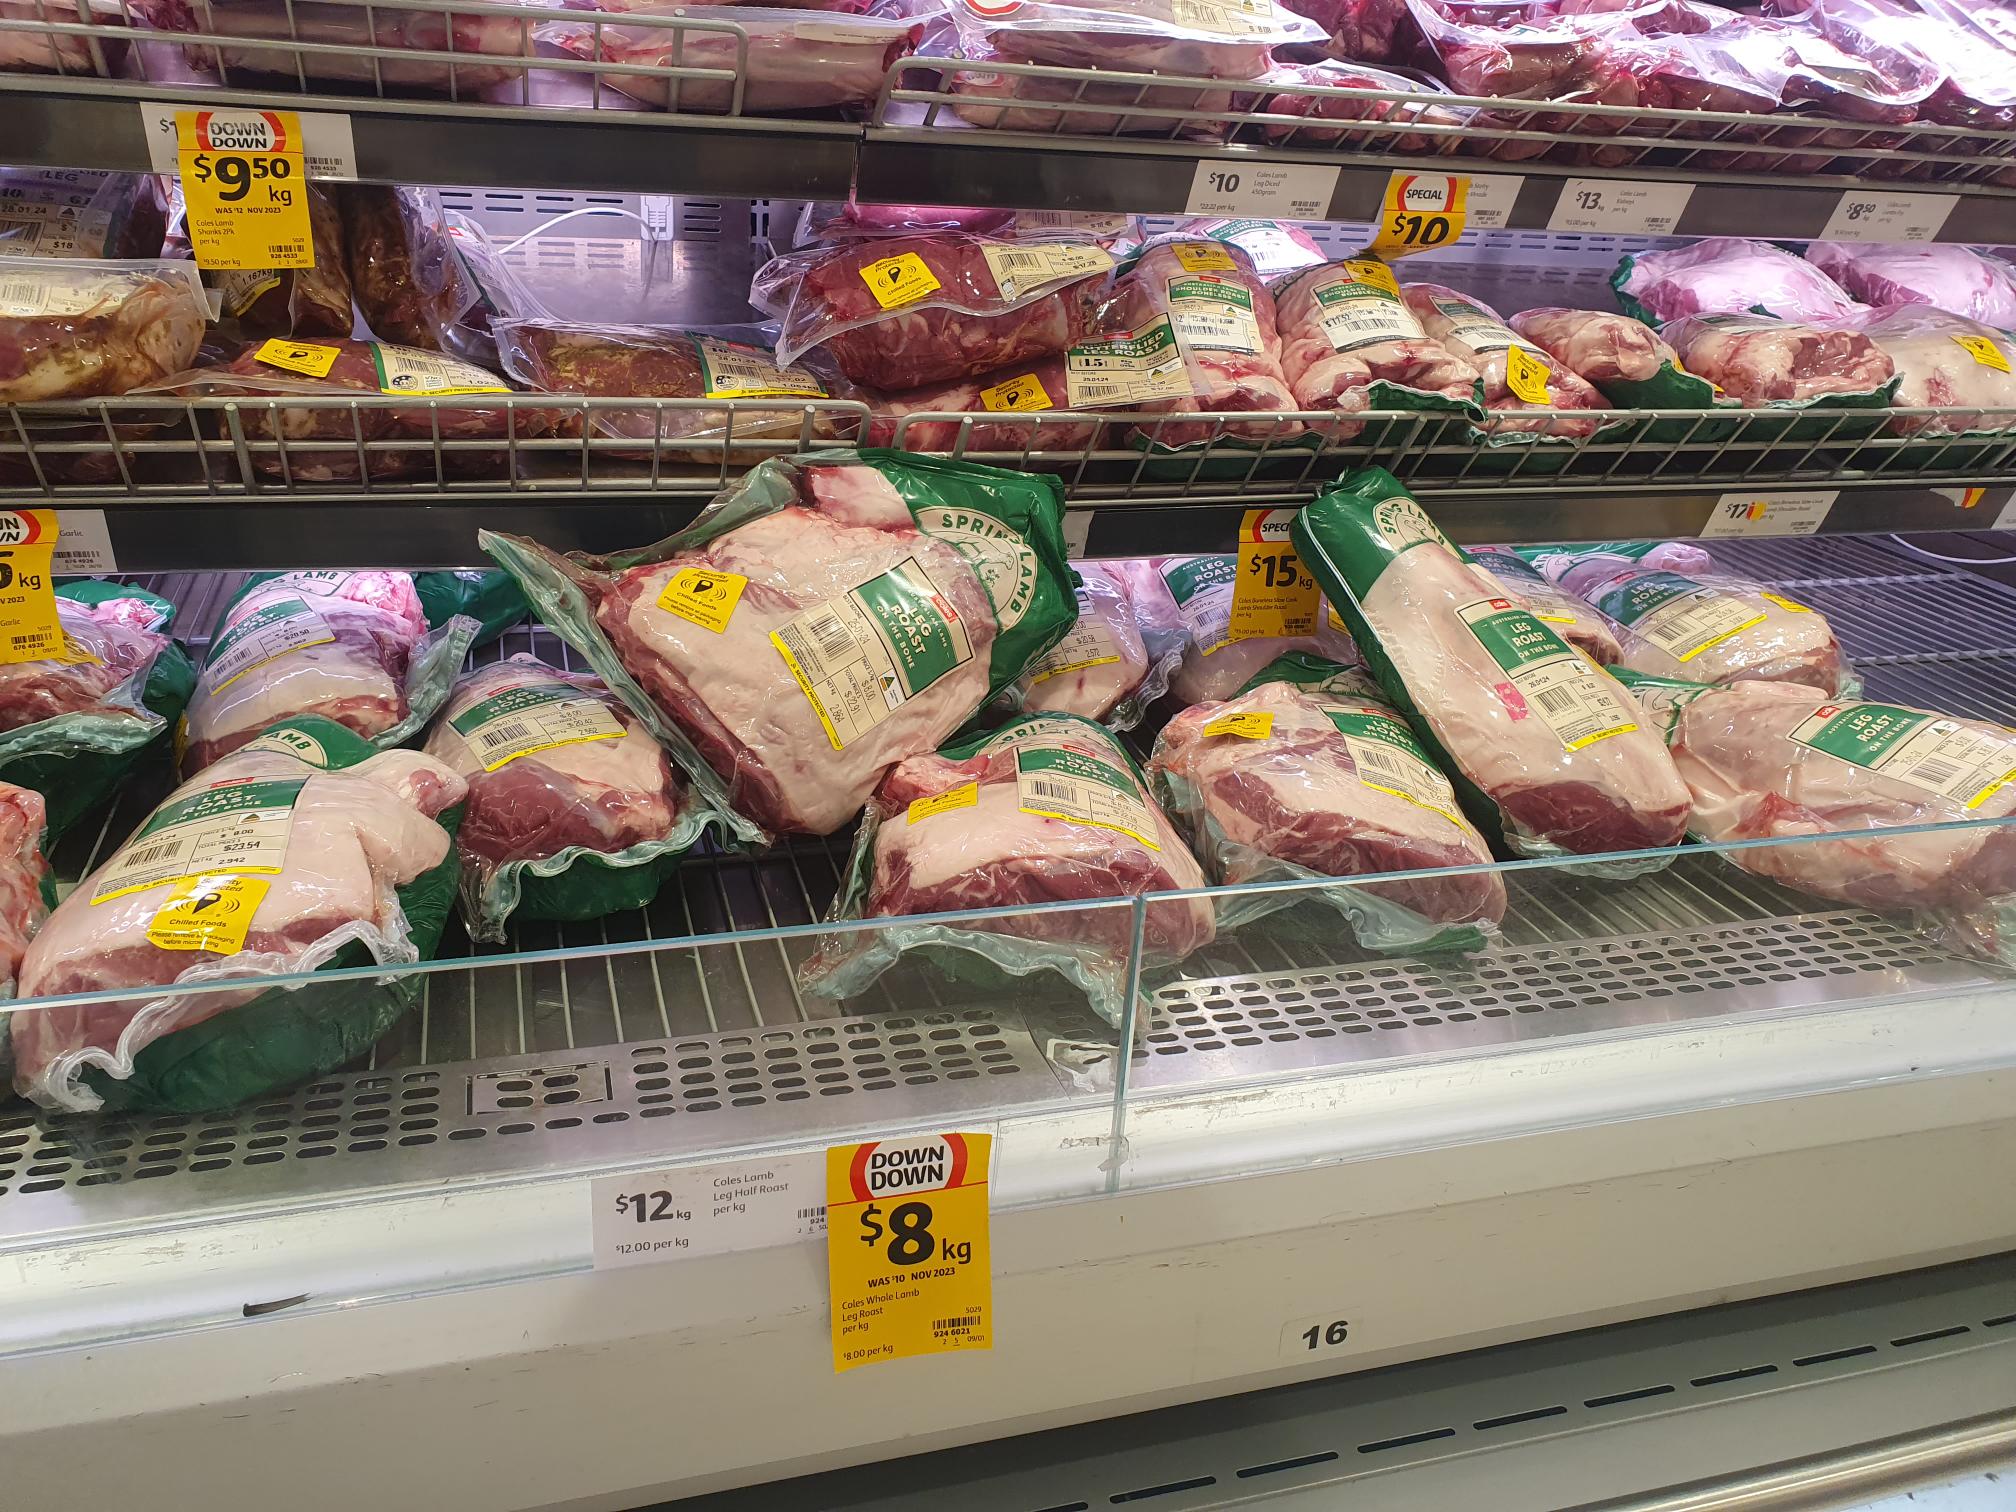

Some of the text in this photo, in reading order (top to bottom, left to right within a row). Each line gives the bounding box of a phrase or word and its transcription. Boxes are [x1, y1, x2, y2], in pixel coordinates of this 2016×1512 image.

[211, 122, 265, 136] DOWN
[213, 137, 267, 149] DOWN
[45, 170, 78, 181] LEG
[1209, 172, 1240, 193] $10
[269, 185, 292, 206] kg
[1406, 189, 1443, 200] SPECIAL
[1575, 190, 1602, 210] $13
[1227, 204, 1235, 212] kg
[196, 219, 234, 227] Coles Lamb
[1391, 212, 1450, 246] $10
[198, 228, 222, 236] Shanks
[200, 237, 220, 246] per kg
[220, 259, 231, 267] per
[232, 258, 241, 267] kg
[1176, 285, 1220, 295] SHOULDER
[1191, 290, 1232, 300] BONELESS
[1077, 332, 1165, 350] BUTTERFLIED
[1114, 343, 1160, 357] ROAST
[1725, 503, 1748, 519] $17
[1194, 564, 1236, 582] ROAST
[1200, 560, 1225, 572] LEG
[1250, 553, 1313, 590] $15 kg
[19, 572, 41, 590] kg
[293, 572, 339, 581] LAMB
[1010, 551, 1033, 613] LAMB
[1631, 582, 1654, 595] LEG
[1632, 583, 1670, 604] ROAST
[7, 596, 25, 604] 2023
[891, 604, 927, 654] ROAST
[909, 607, 932, 637] LEG
[1510, 622, 1532, 634] LEG
[876, 605, 915, 669] ON THE BONE
[938, 628, 947, 648] LAMB
[1512, 632, 1546, 648] ROAST
[1519, 647, 1543, 659] ON THE
[795, 669, 826, 718] SECURITY PROTECTED
[1848, 714, 1873, 732] LEG
[1856, 715, 1895, 743] ROAST
[1869, 717, 1912, 752] ON THE BONE
[182, 795, 256, 815] ROAST
[201, 790, 243, 803] LEG
[193, 800, 262, 817] THE BONE
[223, 841, 261, 852] $23.54
[218, 857, 246, 865] 2.942
[169, 918, 227, 928] Chilled Foods
[871, 1146, 945, 1170] DOWN
[713, 1171, 774, 1188] Coles Lamb
[871, 1164, 944, 1191] DOWN
[713, 1182, 789, 1202] Leg Half Roast
[616, 1190, 692, 1223] $12 kg
[713, 1202, 746, 1217] per kg
[860, 1201, 971, 1266] $8 kg
[616, 1237, 689, 1255] $12.00 per kg
[867, 1267, 956, 1288] WAS $10 NOV 2023
[841, 1288, 920, 1311] Coles Whole Lamb
[842, 1306, 884, 1322] Leg Roast
[965, 1306, 982, 1314] 5029
[842, 1320, 869, 1336] per kg
[933, 1327, 971, 1338] 924 6021
[1302, 1320, 1349, 1350] 16
[967, 1334, 985, 1342] 09/01
[843, 1343, 894, 1361] $8.00 per kg
